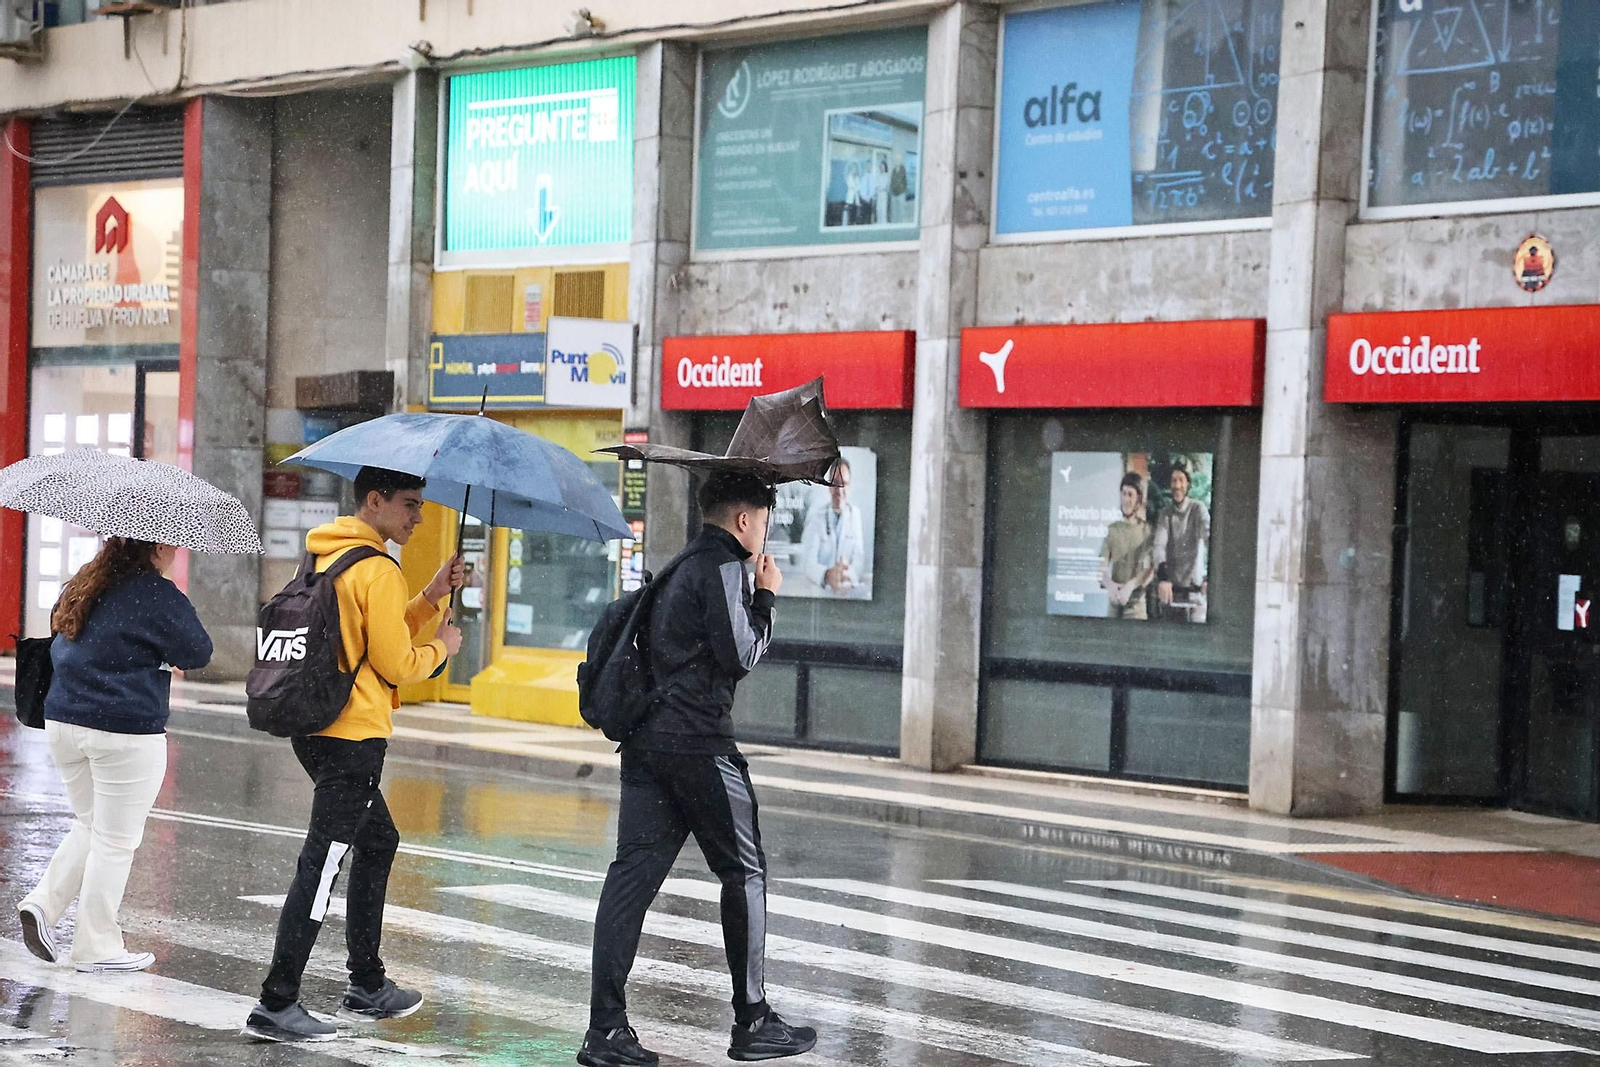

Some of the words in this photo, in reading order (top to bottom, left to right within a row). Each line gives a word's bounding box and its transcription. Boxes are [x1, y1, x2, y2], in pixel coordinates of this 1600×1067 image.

[860, 56, 925, 77] ABOGADOS
[1023, 81, 1102, 128] alfa
[466, 107, 588, 150] PREGUNTE
[464, 150, 519, 196] AQUÍ
[47, 258, 92, 284] CÁMARA
[92, 262, 111, 281] DE
[47, 288, 61, 307] LA
[61, 285, 124, 306] PROPIEDAD
[124, 283, 171, 303] URBANA
[47, 311, 62, 330] DE
[63, 309, 104, 329] HUELVA
[113, 307, 171, 327] PROVINCIA
[677, 355, 764, 389] Occident
[1349, 335, 1482, 376] Occident
[256, 626, 310, 662] VANS
